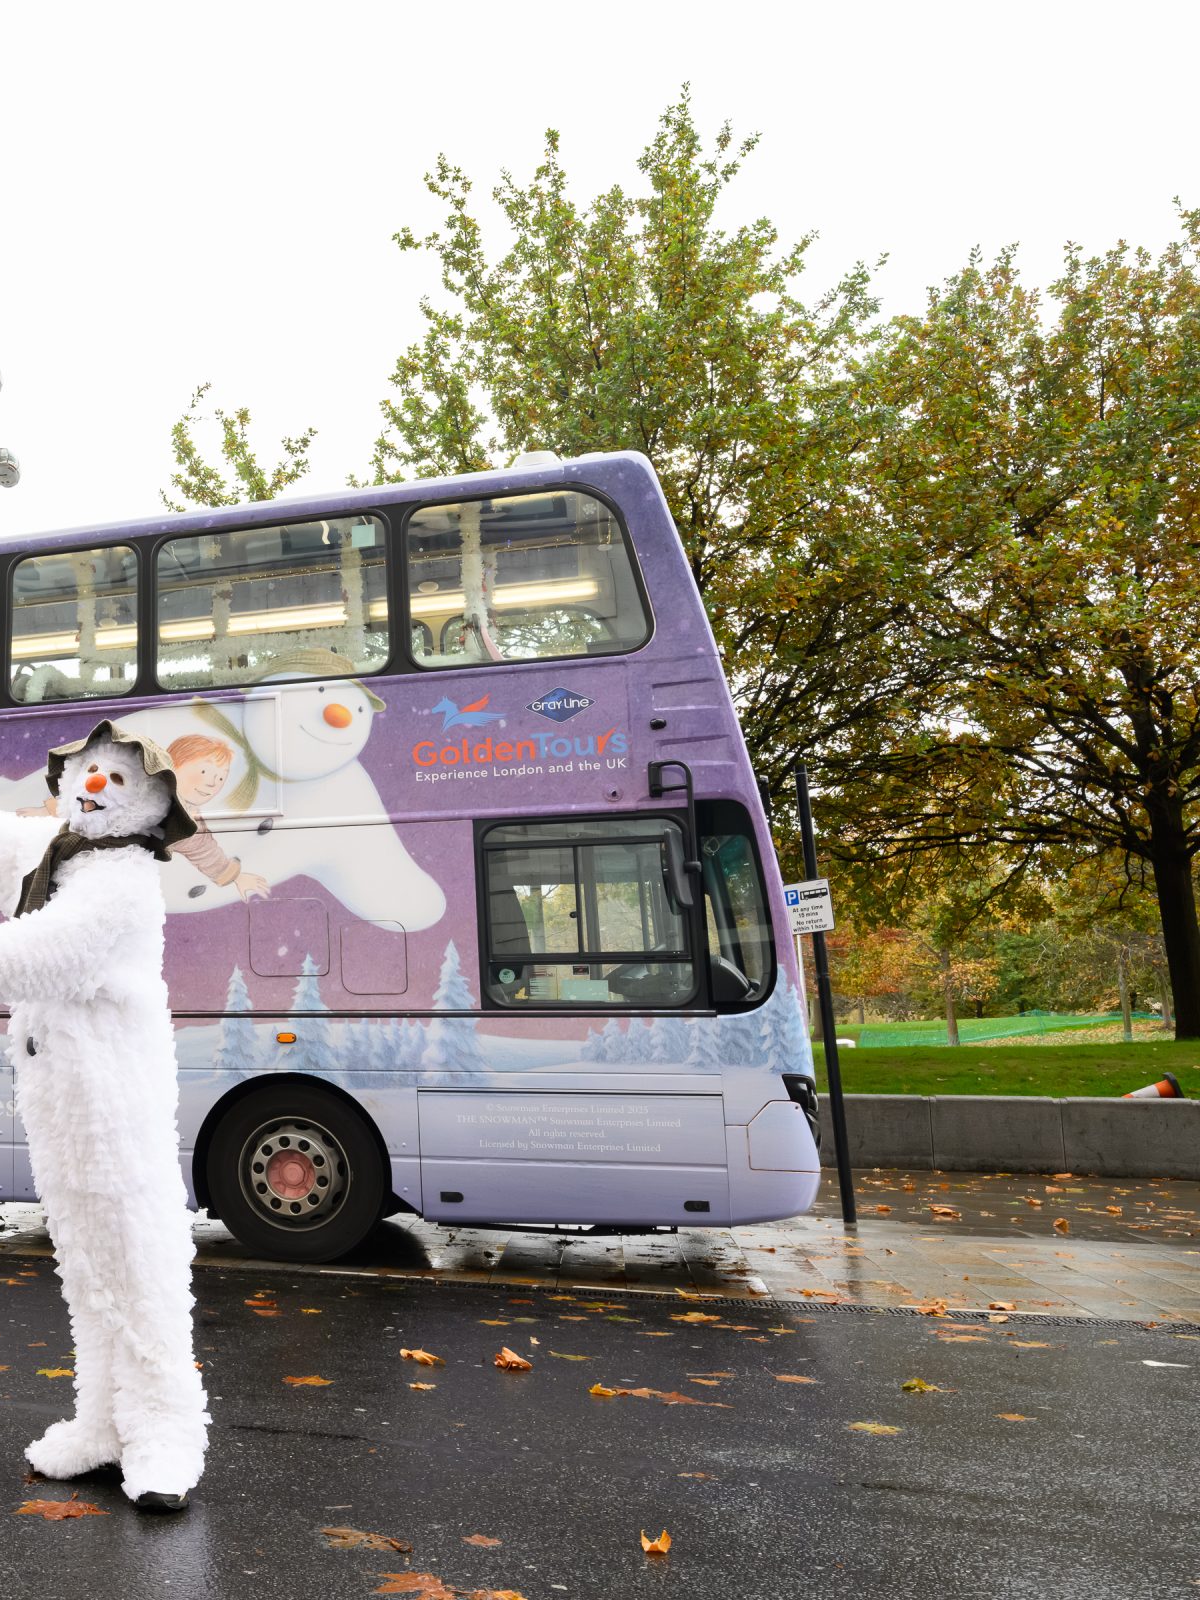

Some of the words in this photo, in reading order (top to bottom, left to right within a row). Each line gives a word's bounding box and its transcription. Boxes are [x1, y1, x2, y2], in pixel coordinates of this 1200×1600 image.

[412, 722, 628, 767] GoldenTours
[415, 769, 488, 784] Experience
[493, 764, 543, 778] London
[548, 761, 573, 773] and
[578, 759, 601, 771] the
[606, 757, 627, 769] UK
[542, 1104, 588, 1115] Enterprises
[591, 1105, 625, 1114] Limited
[456, 1114, 477, 1124] THE
[646, 1118, 681, 1128] Limited
[528, 1128, 541, 1137] All
[543, 1128, 567, 1139] rights
[479, 1139, 515, 1149] Licensed
[517, 1140, 529, 1151] by
[530, 1141, 575, 1150] Snowman
[577, 1141, 624, 1153] Enterprises
[627, 1143, 661, 1152] Limited
